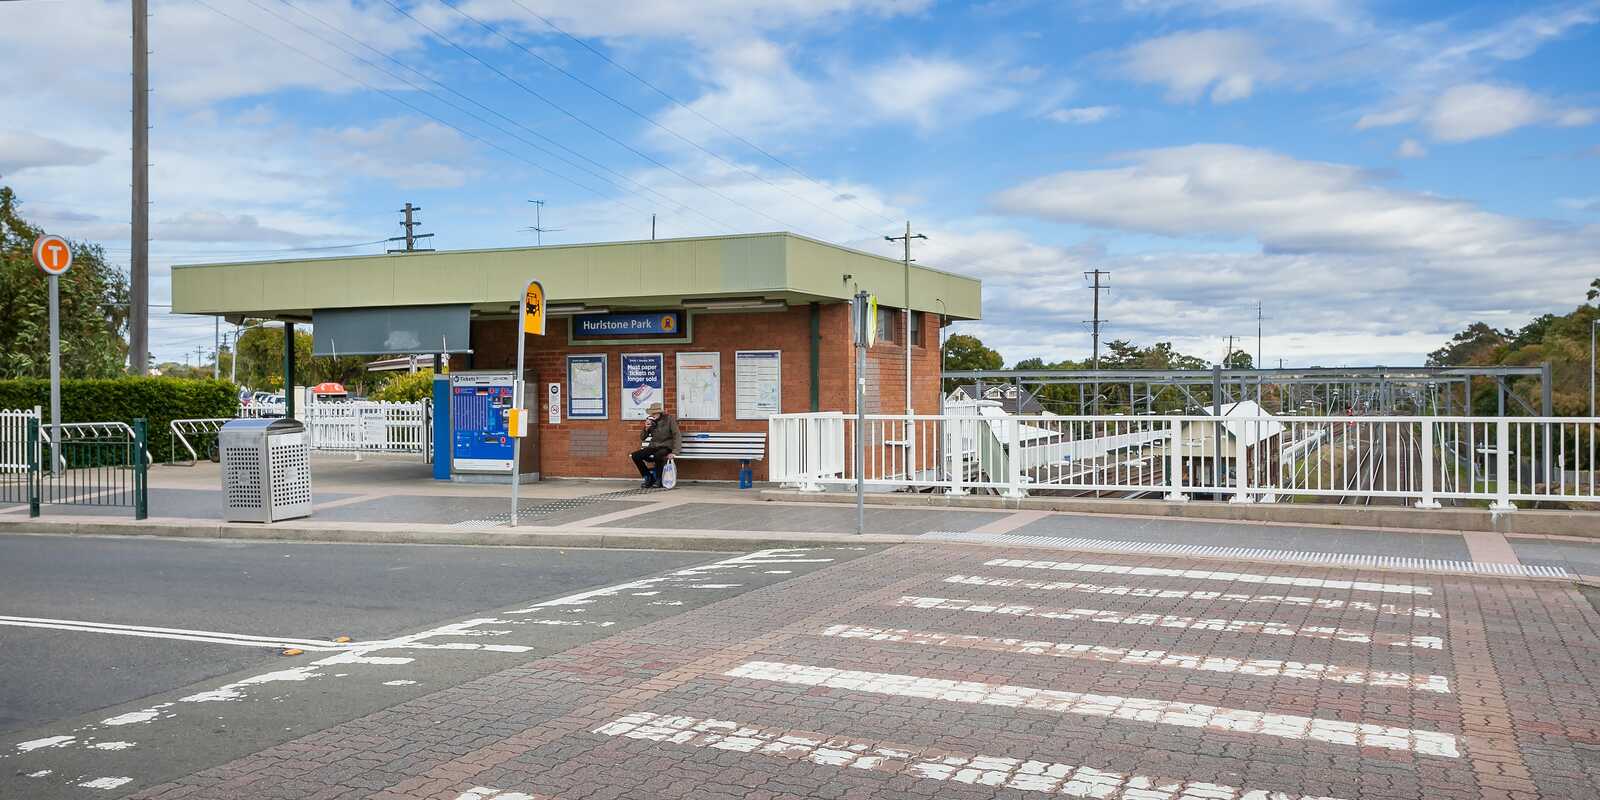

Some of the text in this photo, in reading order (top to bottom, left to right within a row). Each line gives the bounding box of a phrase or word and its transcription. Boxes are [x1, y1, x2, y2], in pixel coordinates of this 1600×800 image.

[47, 246, 62, 266] T
[583, 319, 652, 330] Hurlstone Park
